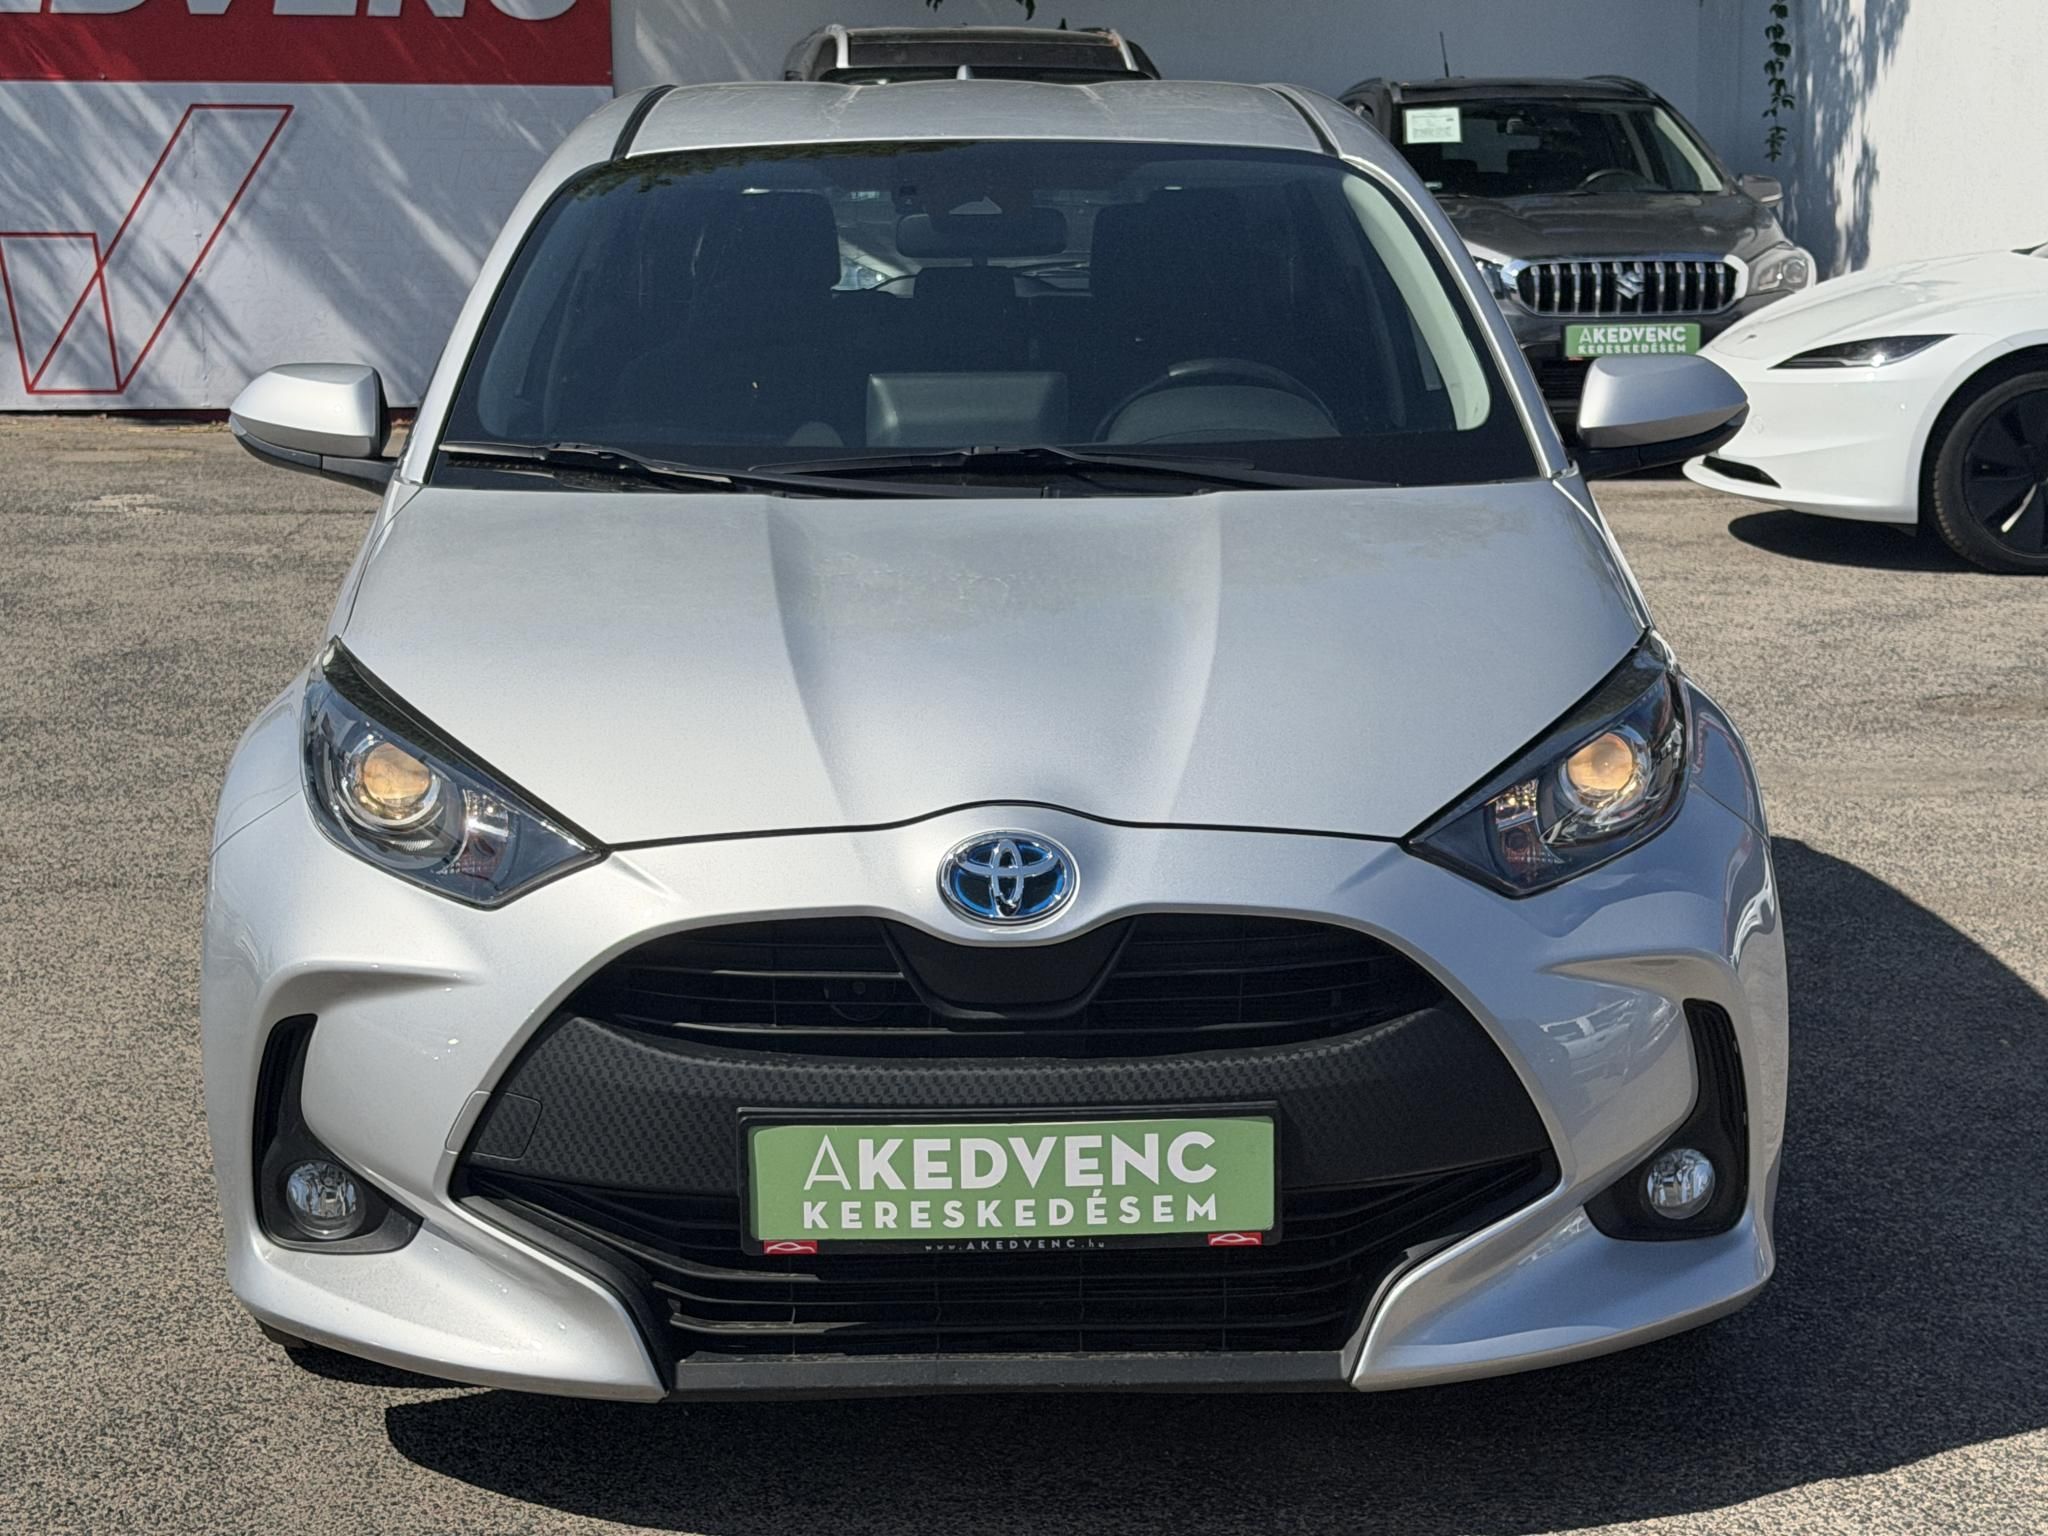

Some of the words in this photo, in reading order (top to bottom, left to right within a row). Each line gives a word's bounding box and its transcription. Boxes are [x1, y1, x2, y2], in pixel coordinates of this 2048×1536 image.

[1579, 326, 1687, 344] AKEDVENC
[803, 1131, 1217, 1190] AKEDVENC
[803, 1189, 1217, 1229] KERESKEDÉSEM
